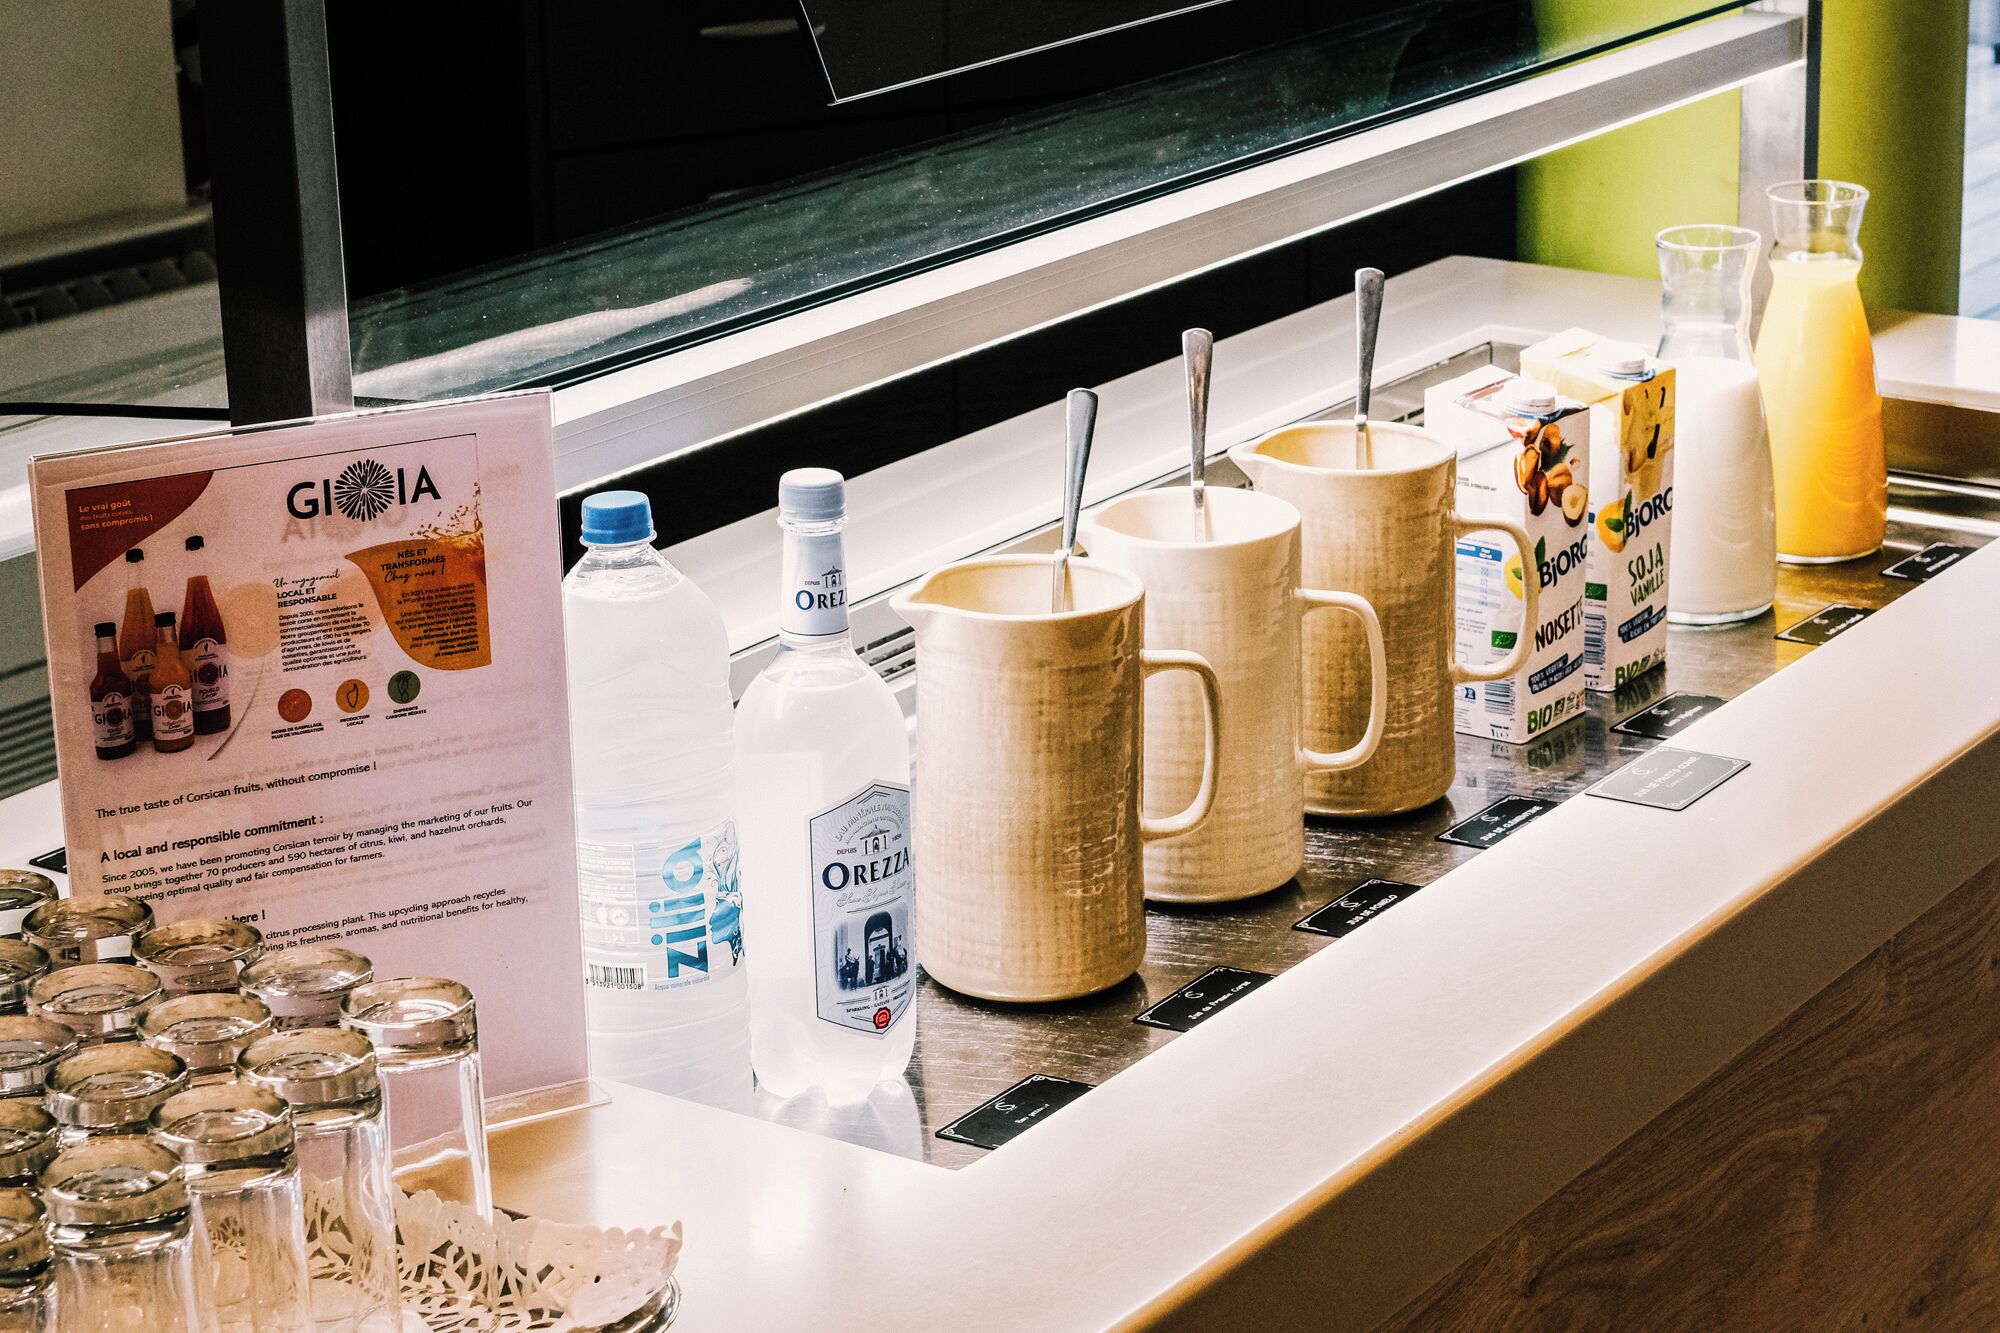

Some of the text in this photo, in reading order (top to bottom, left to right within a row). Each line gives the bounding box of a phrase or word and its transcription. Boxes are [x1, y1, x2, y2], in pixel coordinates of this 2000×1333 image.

[91, 503, 108, 511] vrai
[102, 516, 148, 527] compromis
[381, 555, 446, 571] TRANSFORMÉS
[1628, 543, 1664, 587] SOJA
[277, 590, 304, 599] LOCAL
[278, 593, 337, 608] RESPONSABLE
[796, 588, 847, 610] OREZ
[1630, 569, 1664, 606] VANILLE
[1528, 704, 1552, 734] BIO
[96, 764, 370, 819] The true taste of Corsican fruits, without compromise
[100, 815, 316, 862] A local and responsible commitment
[102, 800, 532, 883] Since 2005, we have been promoting Corsican terroir by managing the marketing of our fruits. Our
[133, 878, 162, 889] brings
[165, 870, 203, 884] together
[206, 866, 218, 876] 70
[221, 860, 265, 876] producers
[268, 854, 284, 865] and
[287, 850, 306, 862] 590
[309, 846, 345, 858] hectares
[348, 841, 358, 851] of
[359, 839, 386, 849] citrus,
[388, 833, 407, 844] kiwi,
[410, 829, 426, 840] and
[429, 822, 465, 836] hazelnut
[467, 816, 506, 830] orchards,
[166, 882, 200, 897] optimal
[203, 877, 232, 891] quality
[235, 873, 252, 884] and
[254, 870, 269, 880] fair
[271, 860, 332, 877] compensation
[335, 858, 347, 866] for
[350, 852, 384, 864] farmers.
[822, 847, 909, 890] OREZZA
[265, 888, 505, 939] citrus processing plant. This upcycling approach recycles
[286, 938, 297, 947] its
[300, 931, 343, 944] freshness,
[345, 924, 379, 936] aromas,
[381, 918, 397, 929] and
[400, 910, 443, 926] nutritional
[446, 904, 479, 917] benefits
[482, 902, 494, 911] for
